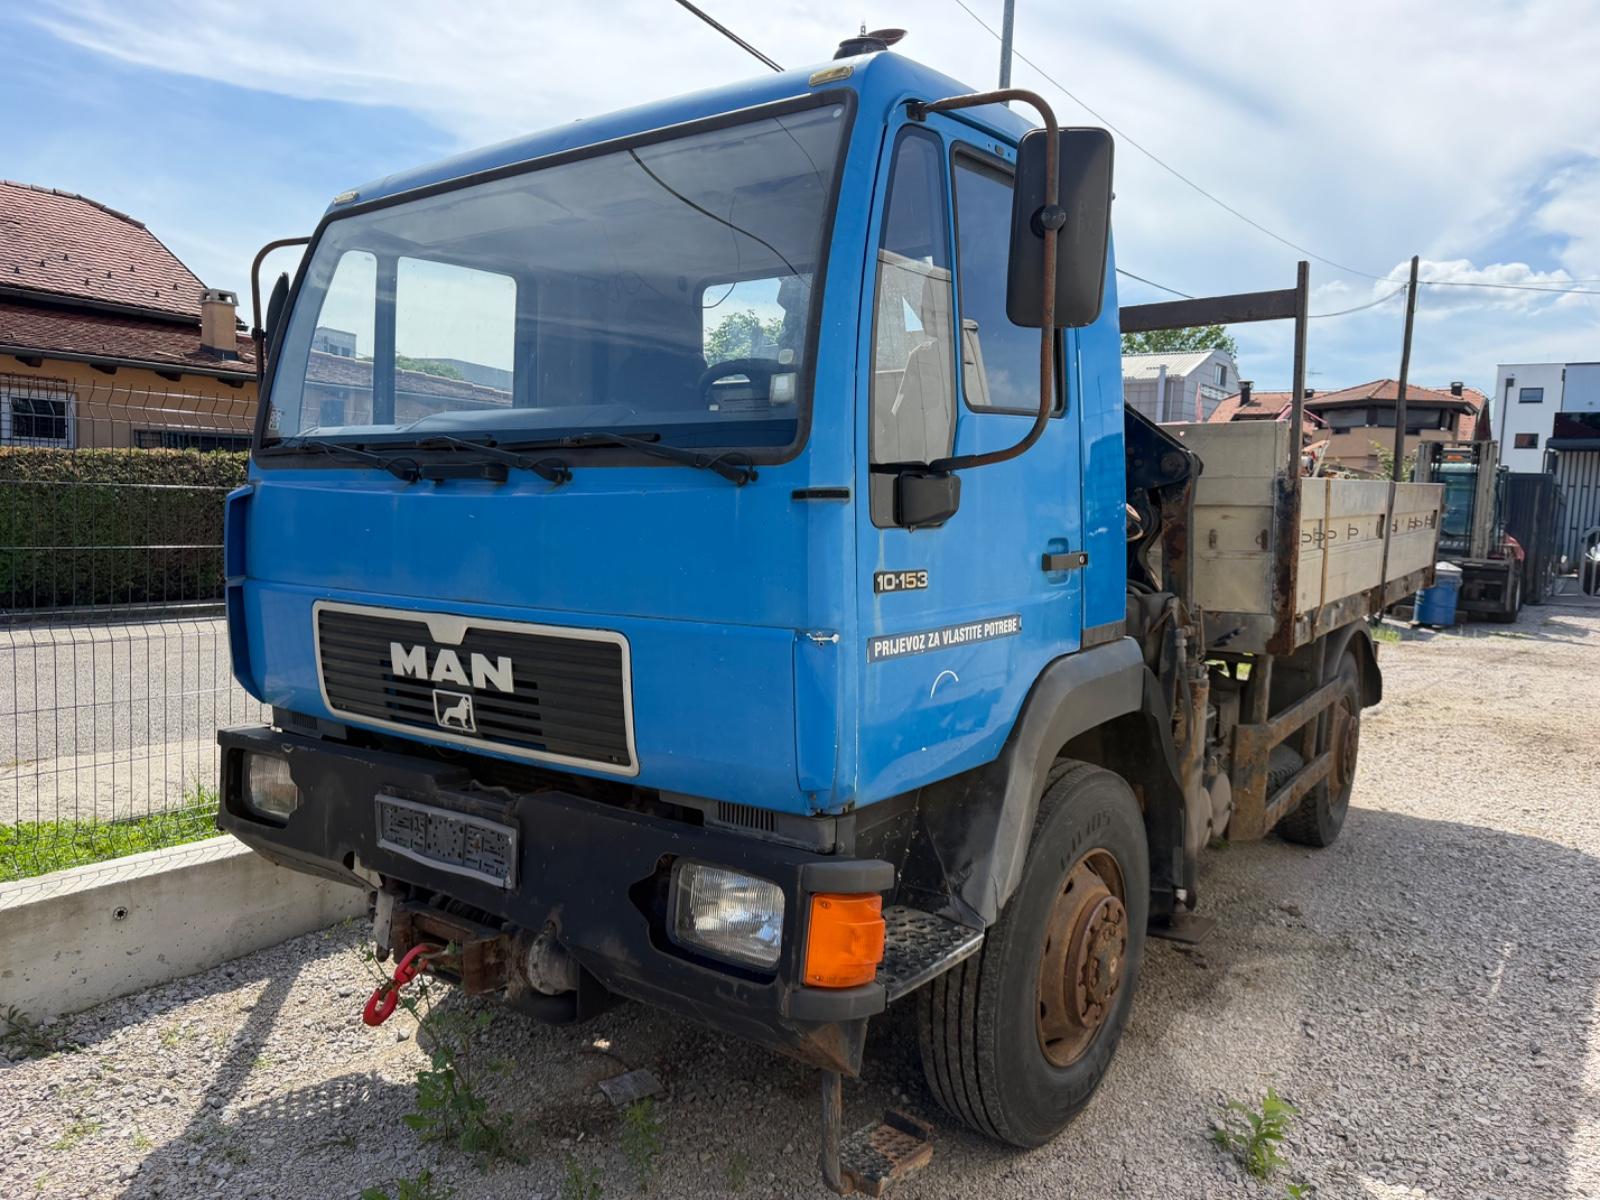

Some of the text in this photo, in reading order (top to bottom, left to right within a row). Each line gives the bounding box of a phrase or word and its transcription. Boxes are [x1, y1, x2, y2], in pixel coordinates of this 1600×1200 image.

[874, 617, 1017, 657] PRIJEVOZ ZA VLASTITE POTREBE
[390, 641, 515, 693] MAN
